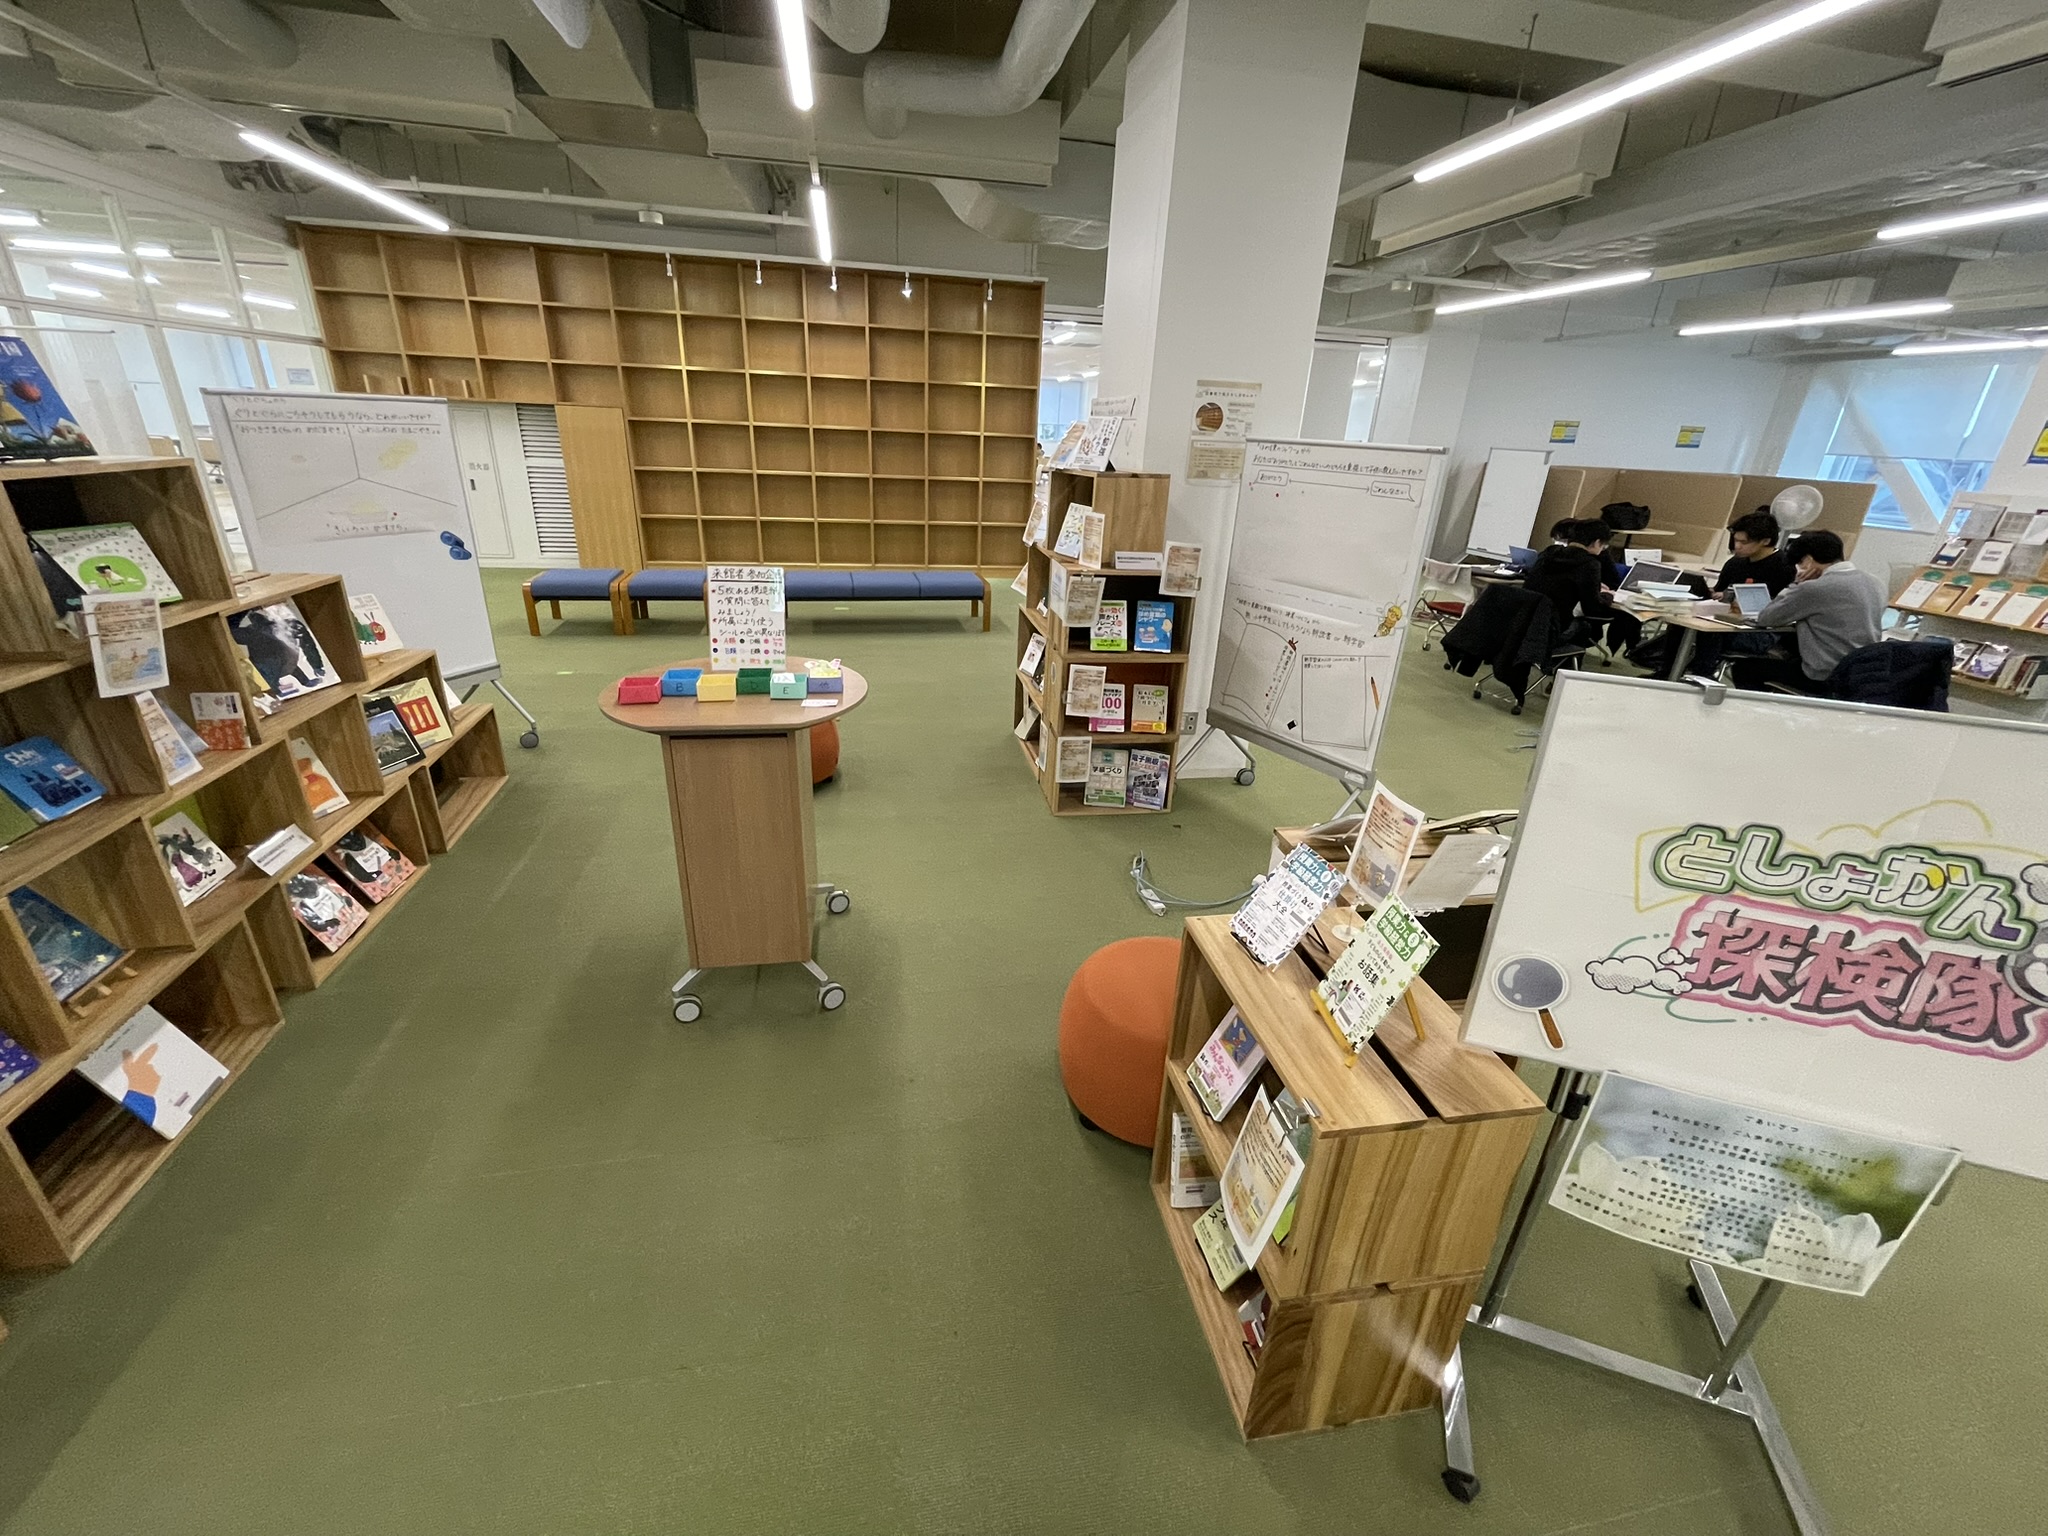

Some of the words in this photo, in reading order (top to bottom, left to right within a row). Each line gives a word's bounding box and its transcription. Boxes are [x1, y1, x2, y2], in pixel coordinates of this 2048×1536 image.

[712, 568, 744, 580] 来館者
[717, 596, 770, 607] の質問に答えて
[718, 616, 774, 627] 所属により使う
[676, 683, 684, 692] B
[783, 686, 789, 695] E
[1658, 827, 2032, 946] としょかん
[1270, 899, 1289, 916] 大全
[1376, 917, 1411, 960] 学級経営力
[1356, 958, 1379, 988] お話集
[1684, 908, 2034, 1047] 探検隊
